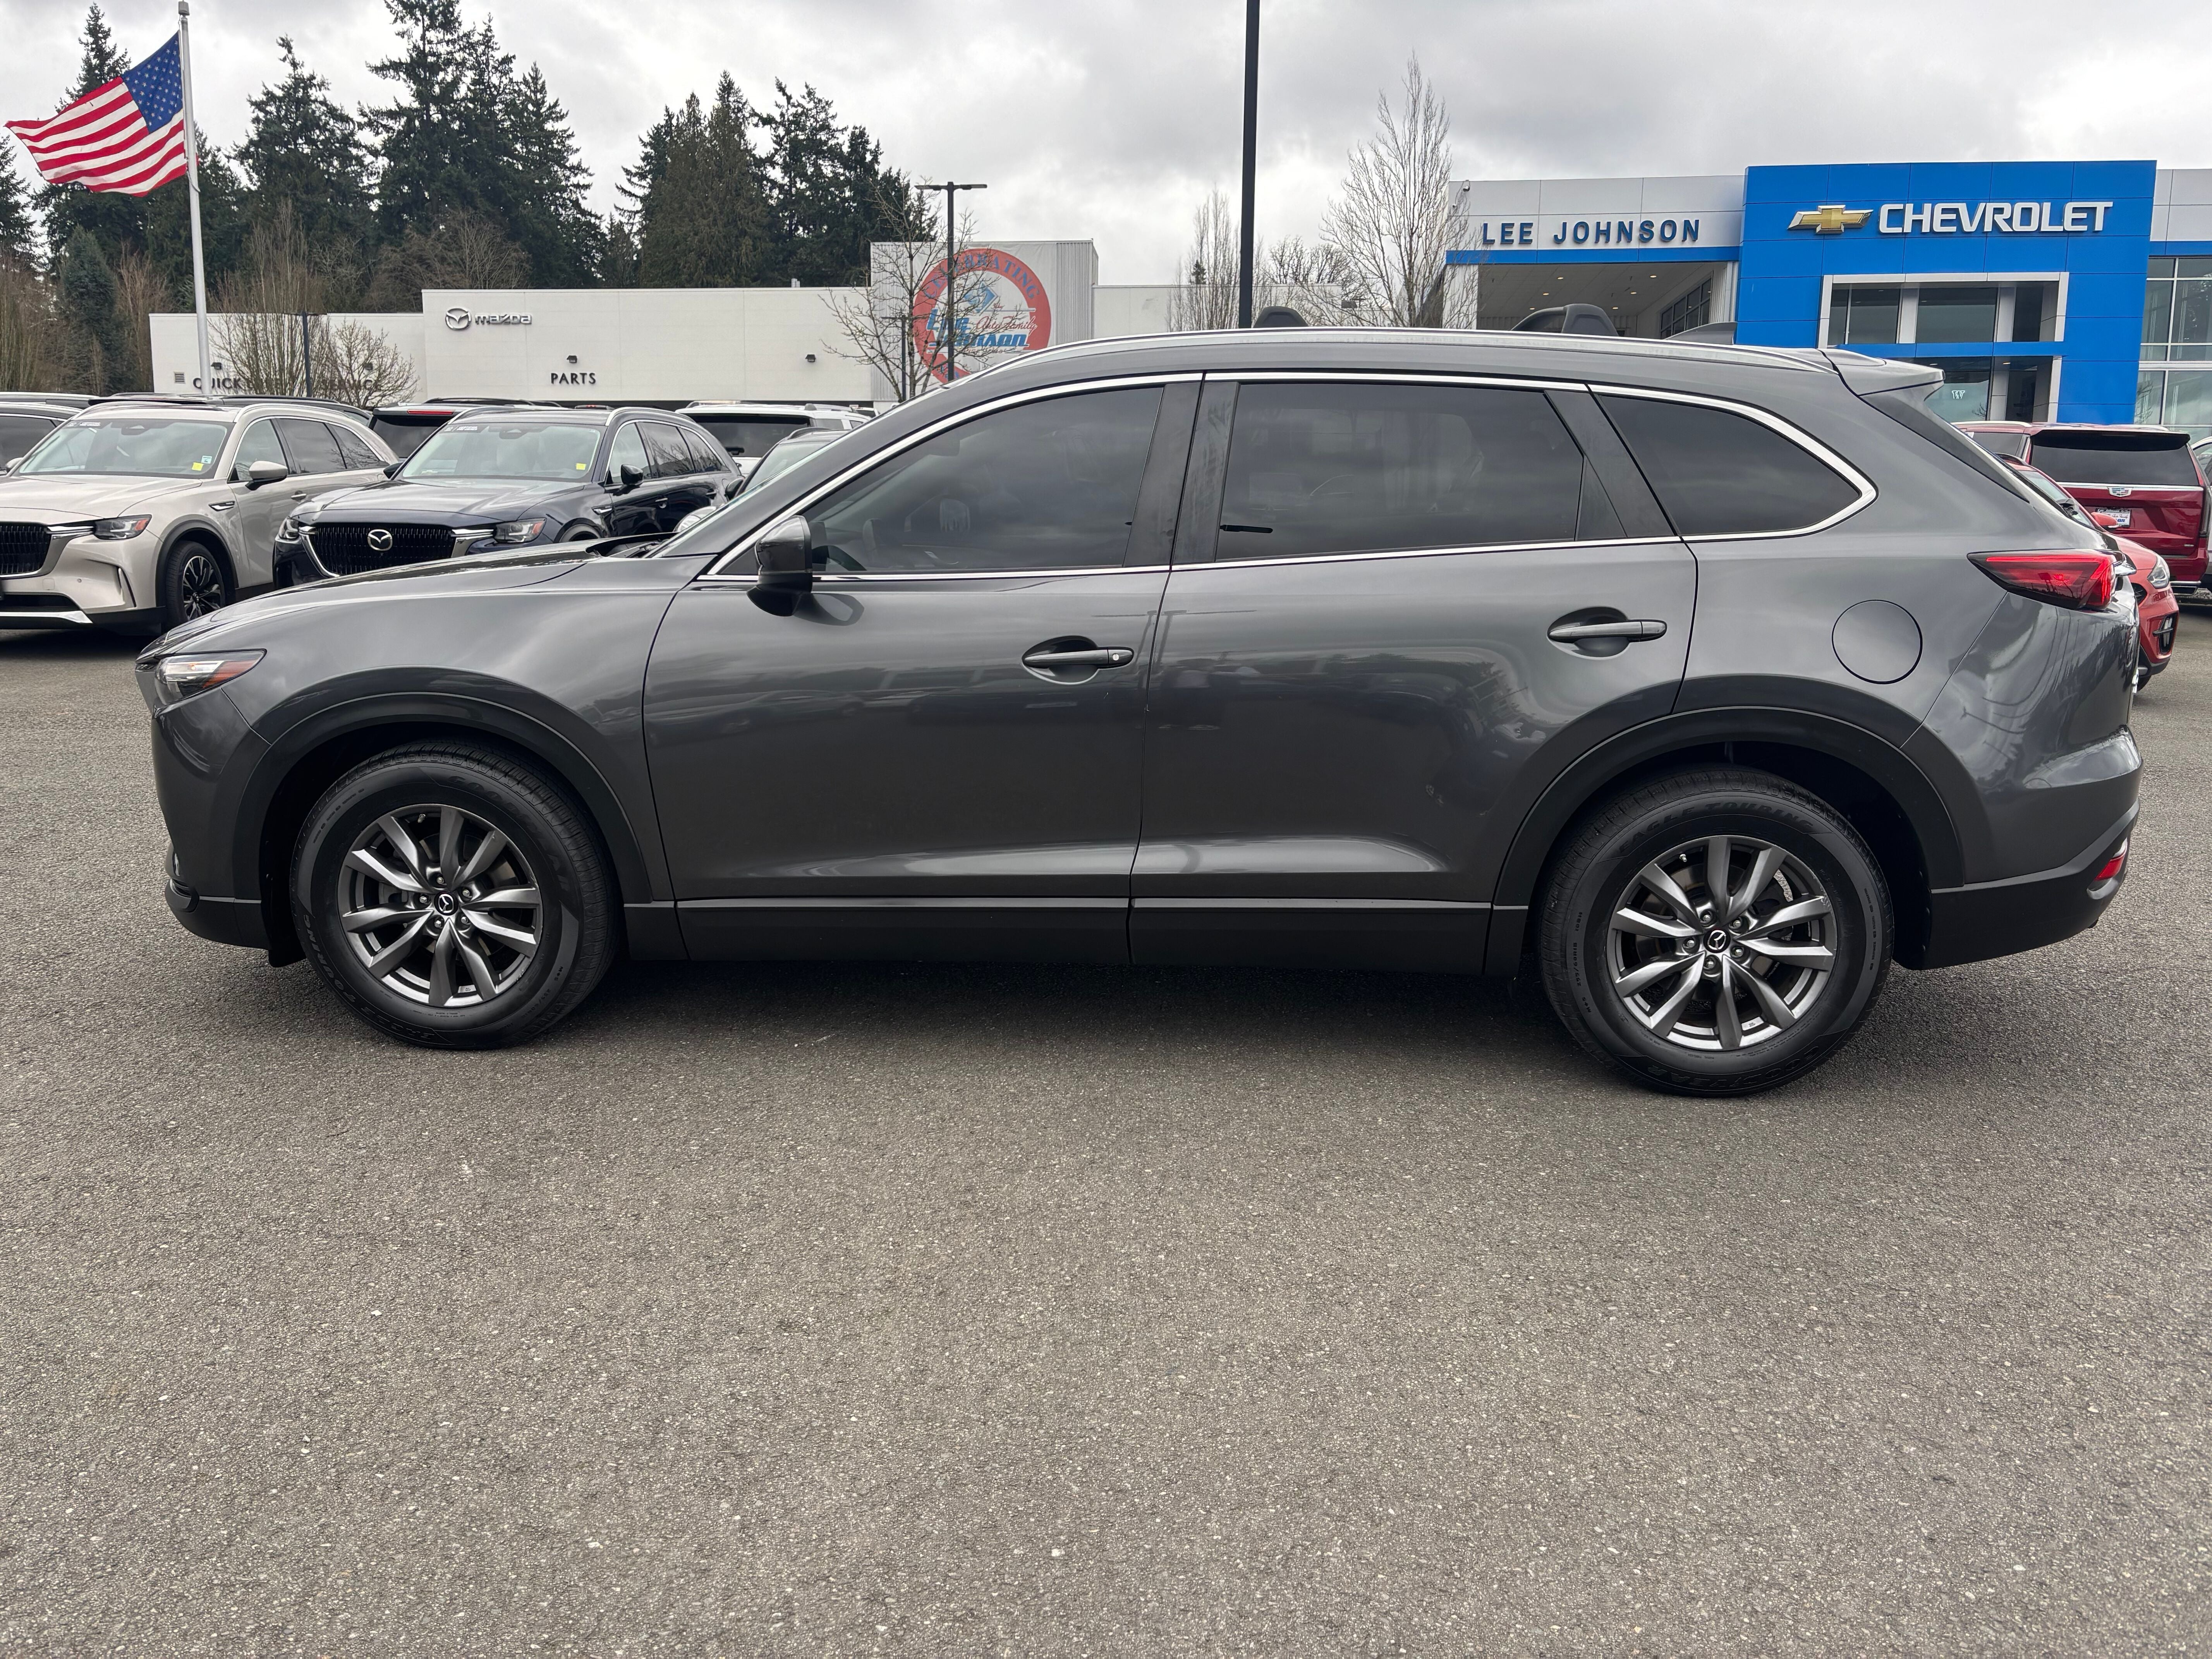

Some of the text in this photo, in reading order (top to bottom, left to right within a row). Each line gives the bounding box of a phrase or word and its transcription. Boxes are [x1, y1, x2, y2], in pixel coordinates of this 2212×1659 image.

[1879, 202, 2113, 233] CHEVROLET
[1482, 219, 1699, 244] LEE JOHNSON
[475, 314, 532, 325] mazda
[551, 373, 596, 385] PARTS
[1618, 802, 1814, 854] EAGLE TOURING
